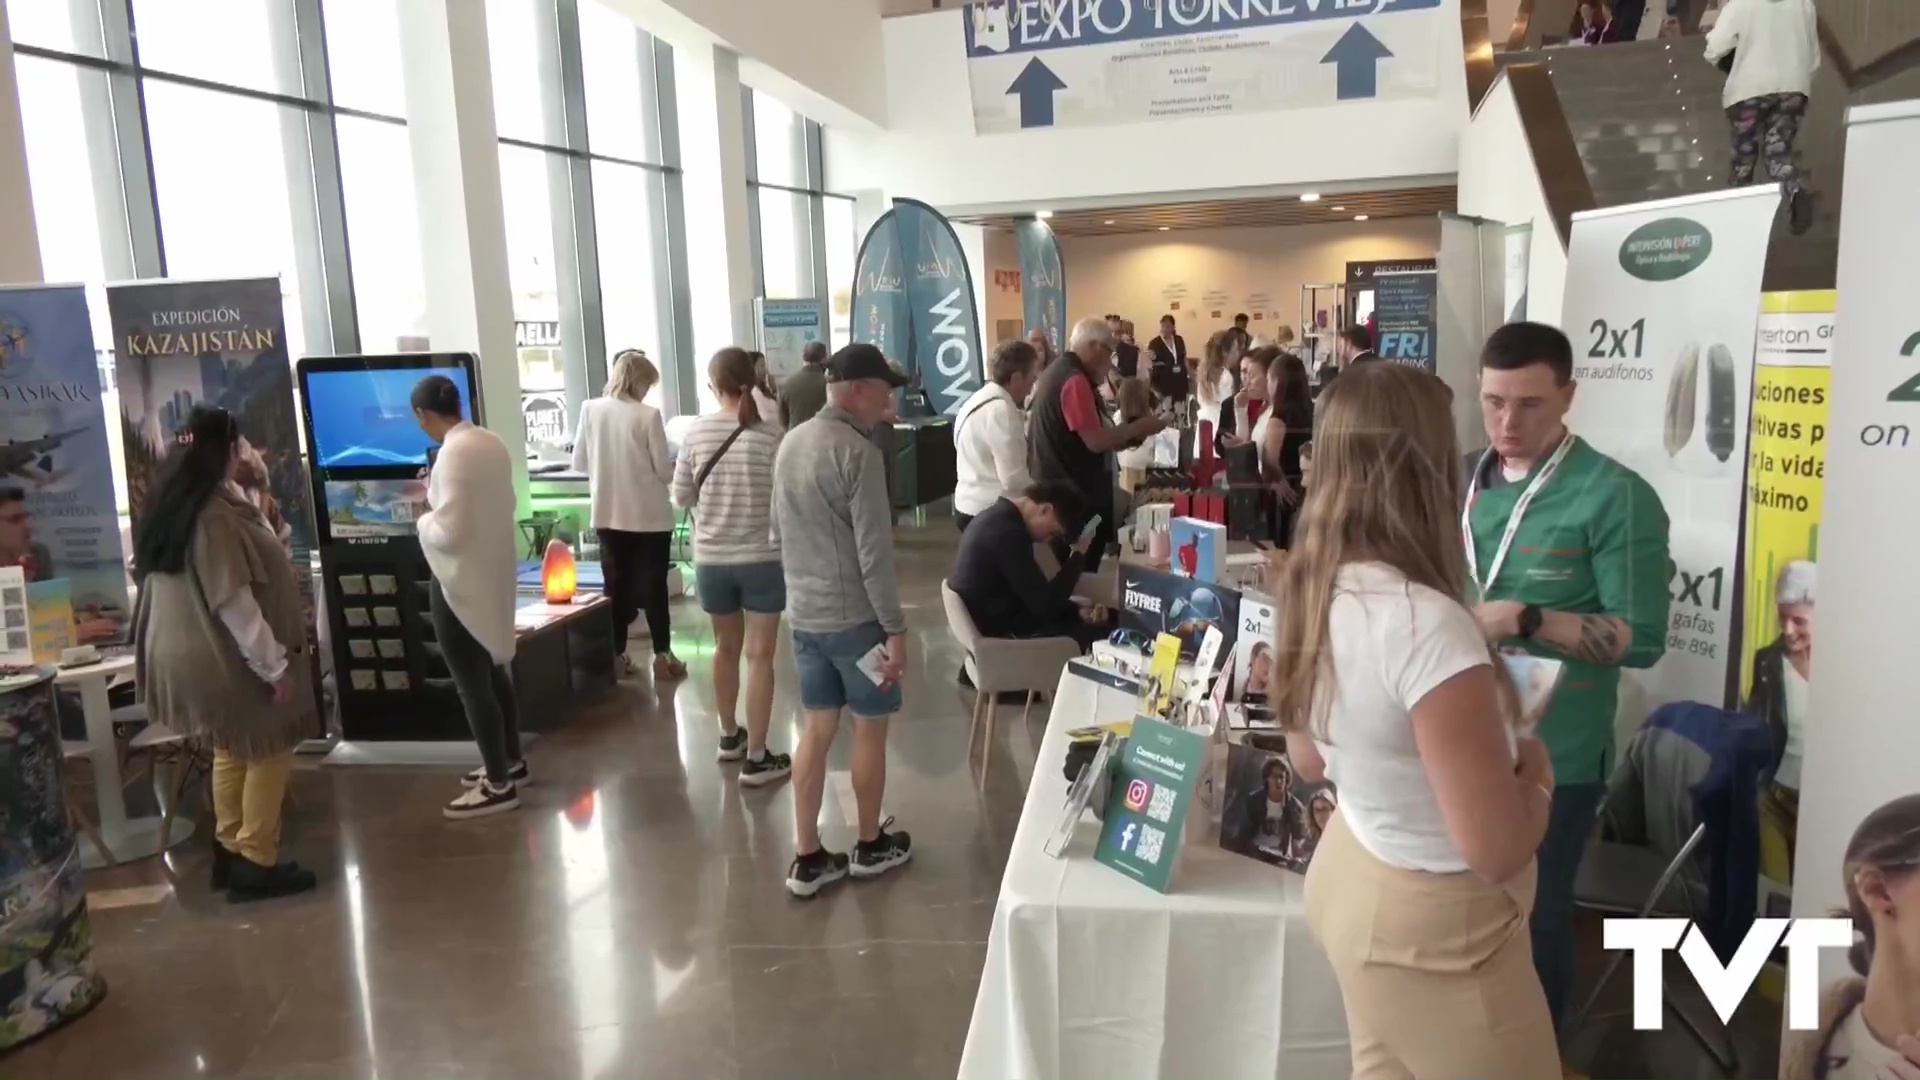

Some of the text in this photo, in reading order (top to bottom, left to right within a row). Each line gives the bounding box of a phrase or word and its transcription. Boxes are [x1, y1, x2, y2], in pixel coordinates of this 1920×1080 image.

[1020, 0, 1132, 44] EXPO
[152, 305, 240, 327] EXPEDICIÓN
[127, 323, 274, 357] KAZAJISTÁN
[1587, 317, 1645, 358] 2x1
[1574, 362, 1654, 381] en audífonos
[1860, 424, 1910, 447] on
[1760, 451, 1774, 473] la
[1125, 588, 1162, 614] FLYFREE
[1244, 617, 1262, 635] 2x1
[1671, 612, 1715, 636] gafas
[1667, 634, 1718, 660] de 89€
